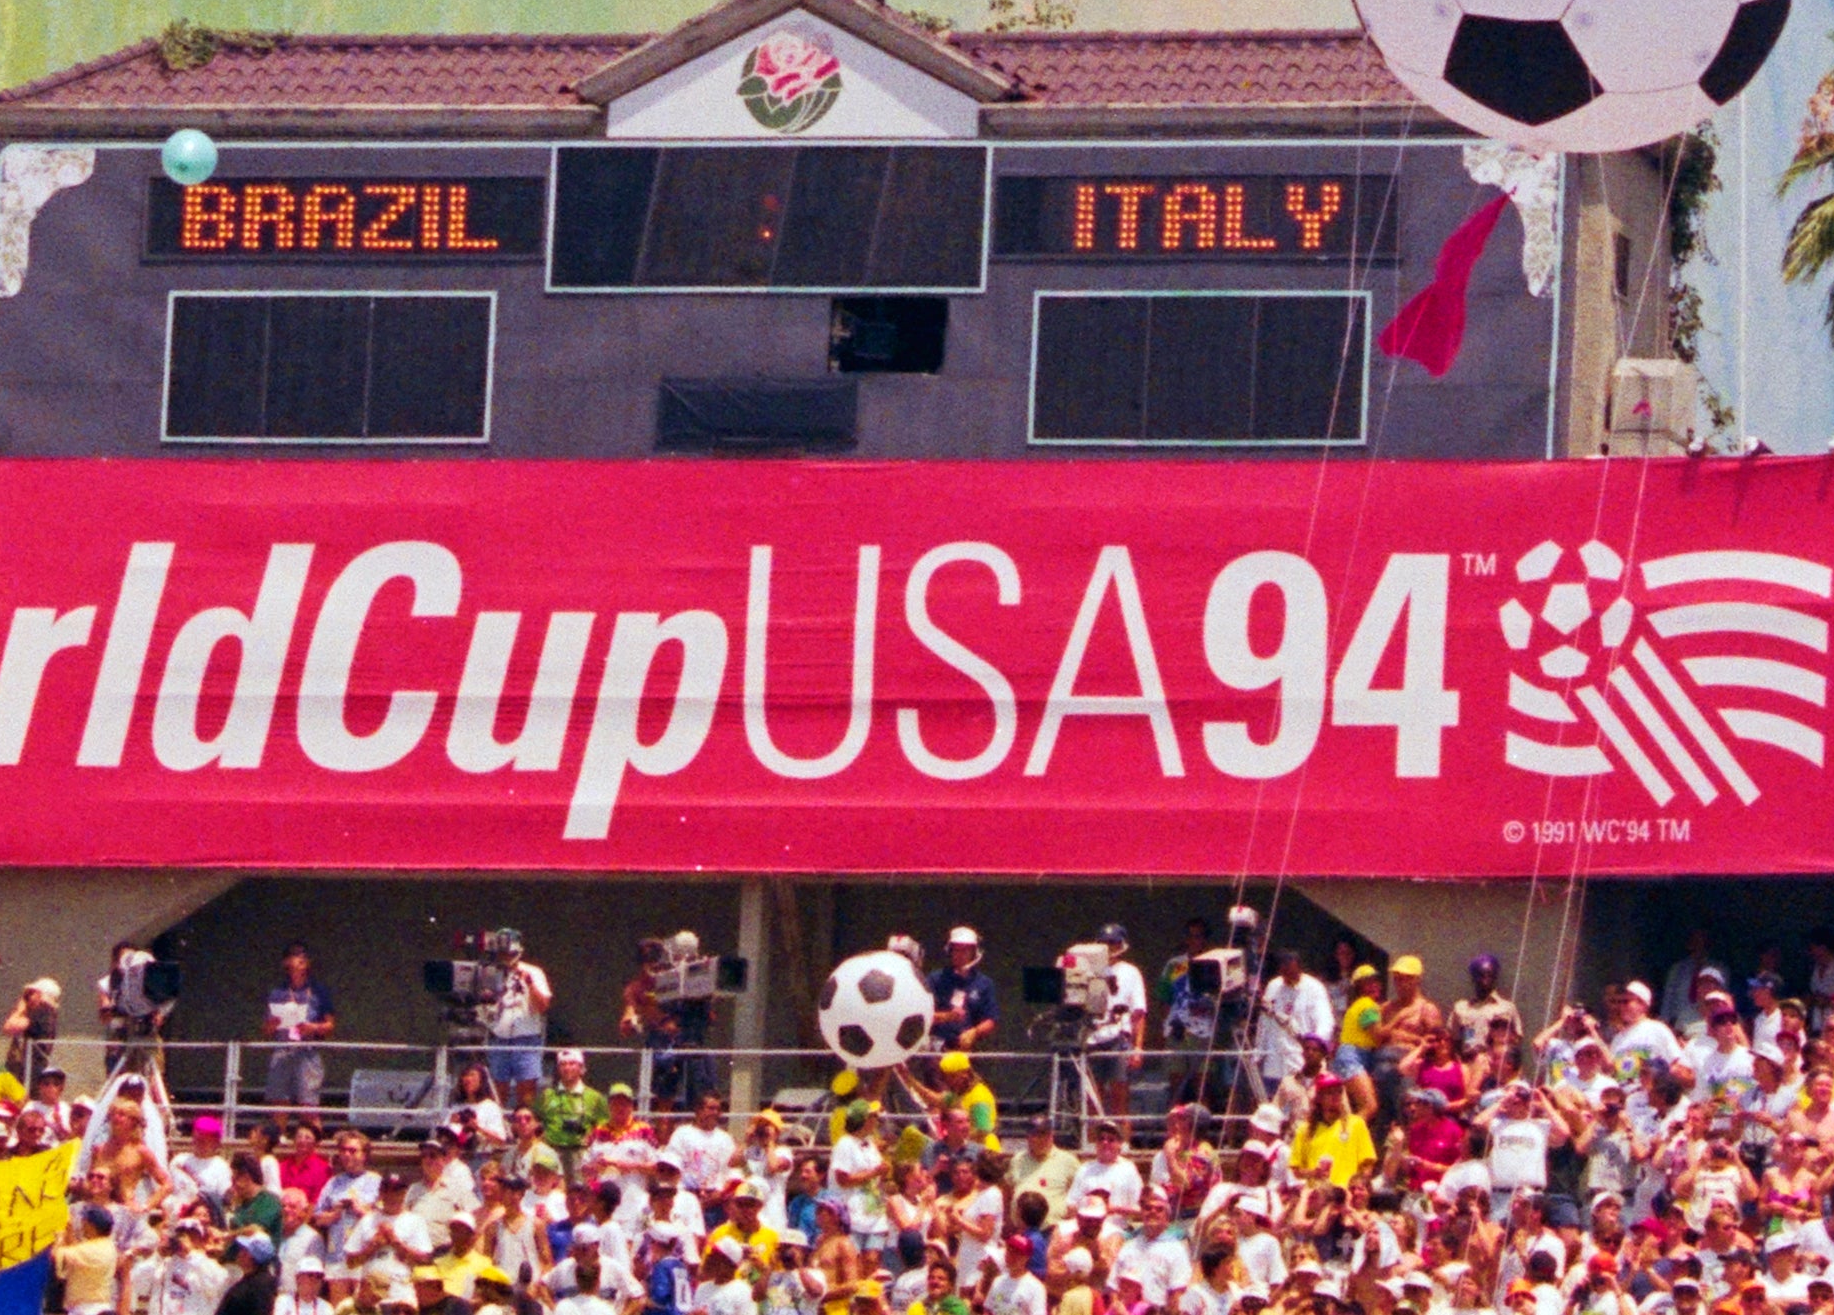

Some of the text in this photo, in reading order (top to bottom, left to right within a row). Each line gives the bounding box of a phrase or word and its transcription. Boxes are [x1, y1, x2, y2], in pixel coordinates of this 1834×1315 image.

[181, 183, 499, 249] BRAZIL
[1073, 183, 1341, 249] ITALY
[1532, 821, 1576, 843] 1991
[1656, 819, 1691, 841] TM
